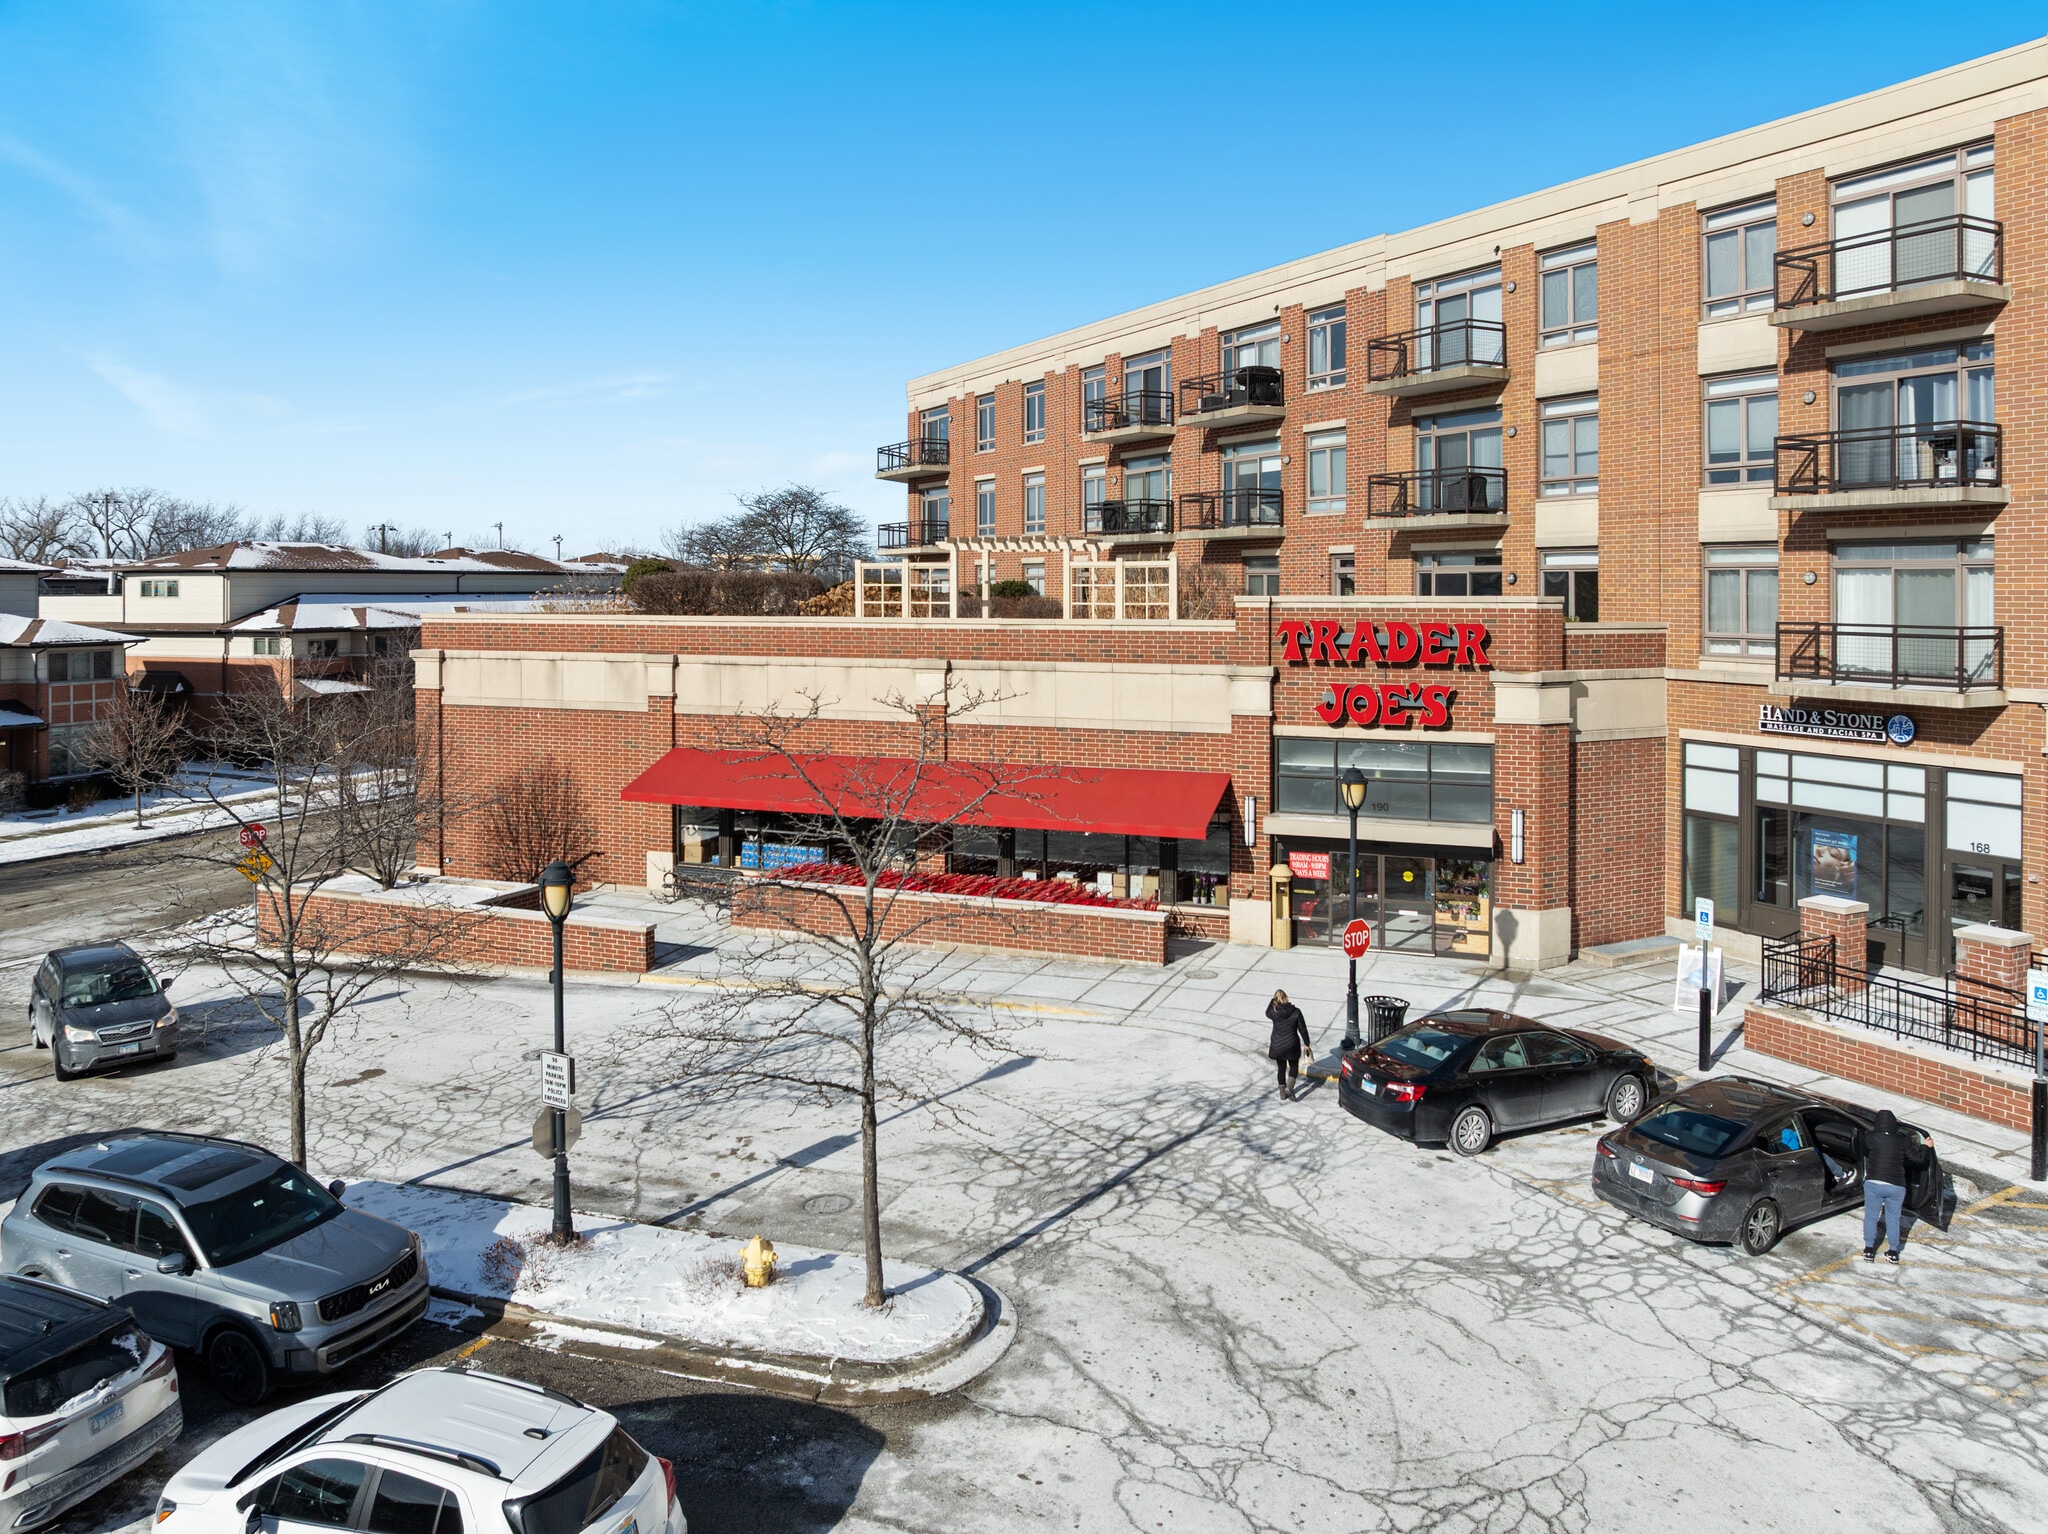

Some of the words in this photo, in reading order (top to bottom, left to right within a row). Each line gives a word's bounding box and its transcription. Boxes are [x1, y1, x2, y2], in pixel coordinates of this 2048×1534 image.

[1275, 620, 1491, 665] TRADER
[1313, 682, 1452, 726] JOE'S
[1758, 704, 1807, 723] HAND
[1809, 712, 1821, 725] &
[1824, 709, 1884, 729] STONE
[1766, 723, 1804, 733] MASSAGE
[1806, 727, 1824, 735] AND
[1828, 729, 1859, 738] FACIAL
[1861, 731, 1877, 739] SPA
[1371, 802, 1389, 812] 190
[1970, 842, 1991, 854] 168
[1289, 853, 1311, 861] TRADING
[1311, 855, 1330, 863] HOURS
[1344, 930, 1369, 949] STOP
[546, 1064, 563, 1072] MINUTE
[545, 1071, 565, 1081] PARKING
[547, 1087, 563, 1096] POLICE
[544, 1094, 566, 1105] ENFORCED
